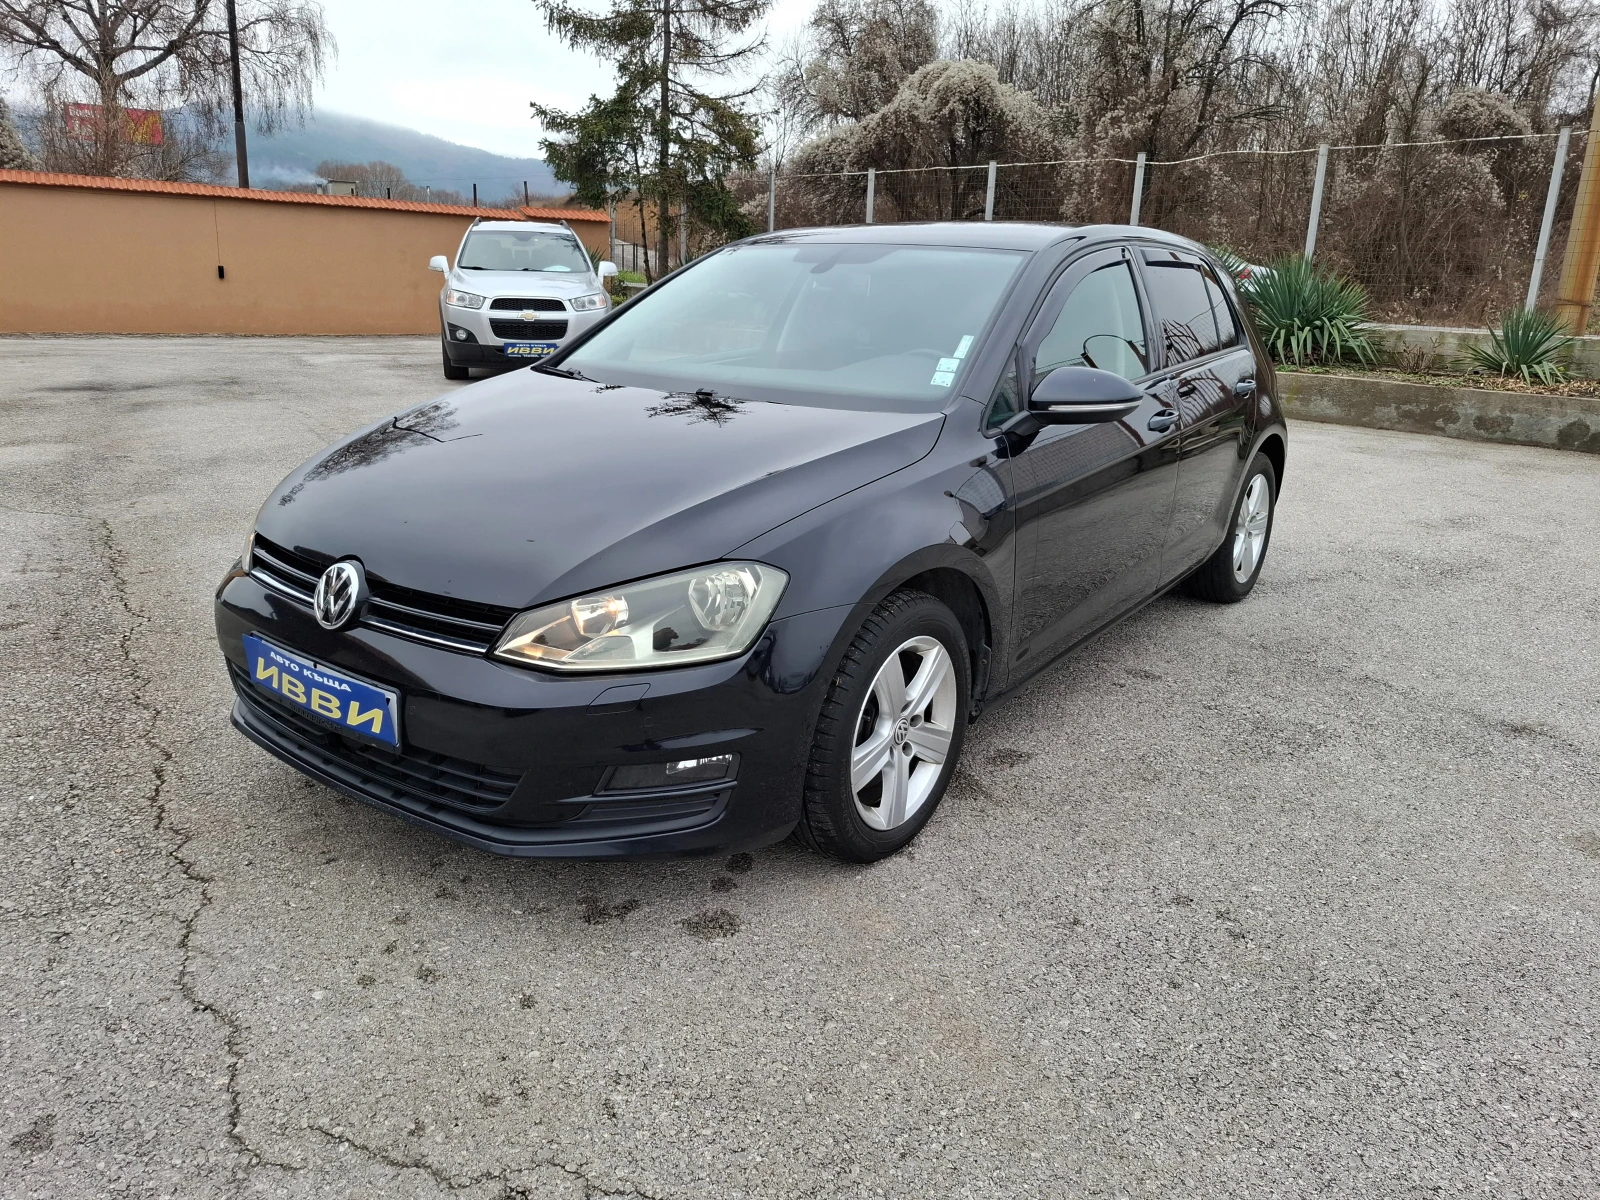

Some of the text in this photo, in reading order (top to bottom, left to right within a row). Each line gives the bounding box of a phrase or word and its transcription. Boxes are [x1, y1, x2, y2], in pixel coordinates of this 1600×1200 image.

[256, 657, 384, 734] ИВВИ
[270, 651, 352, 692] АВТО КЪЩА
